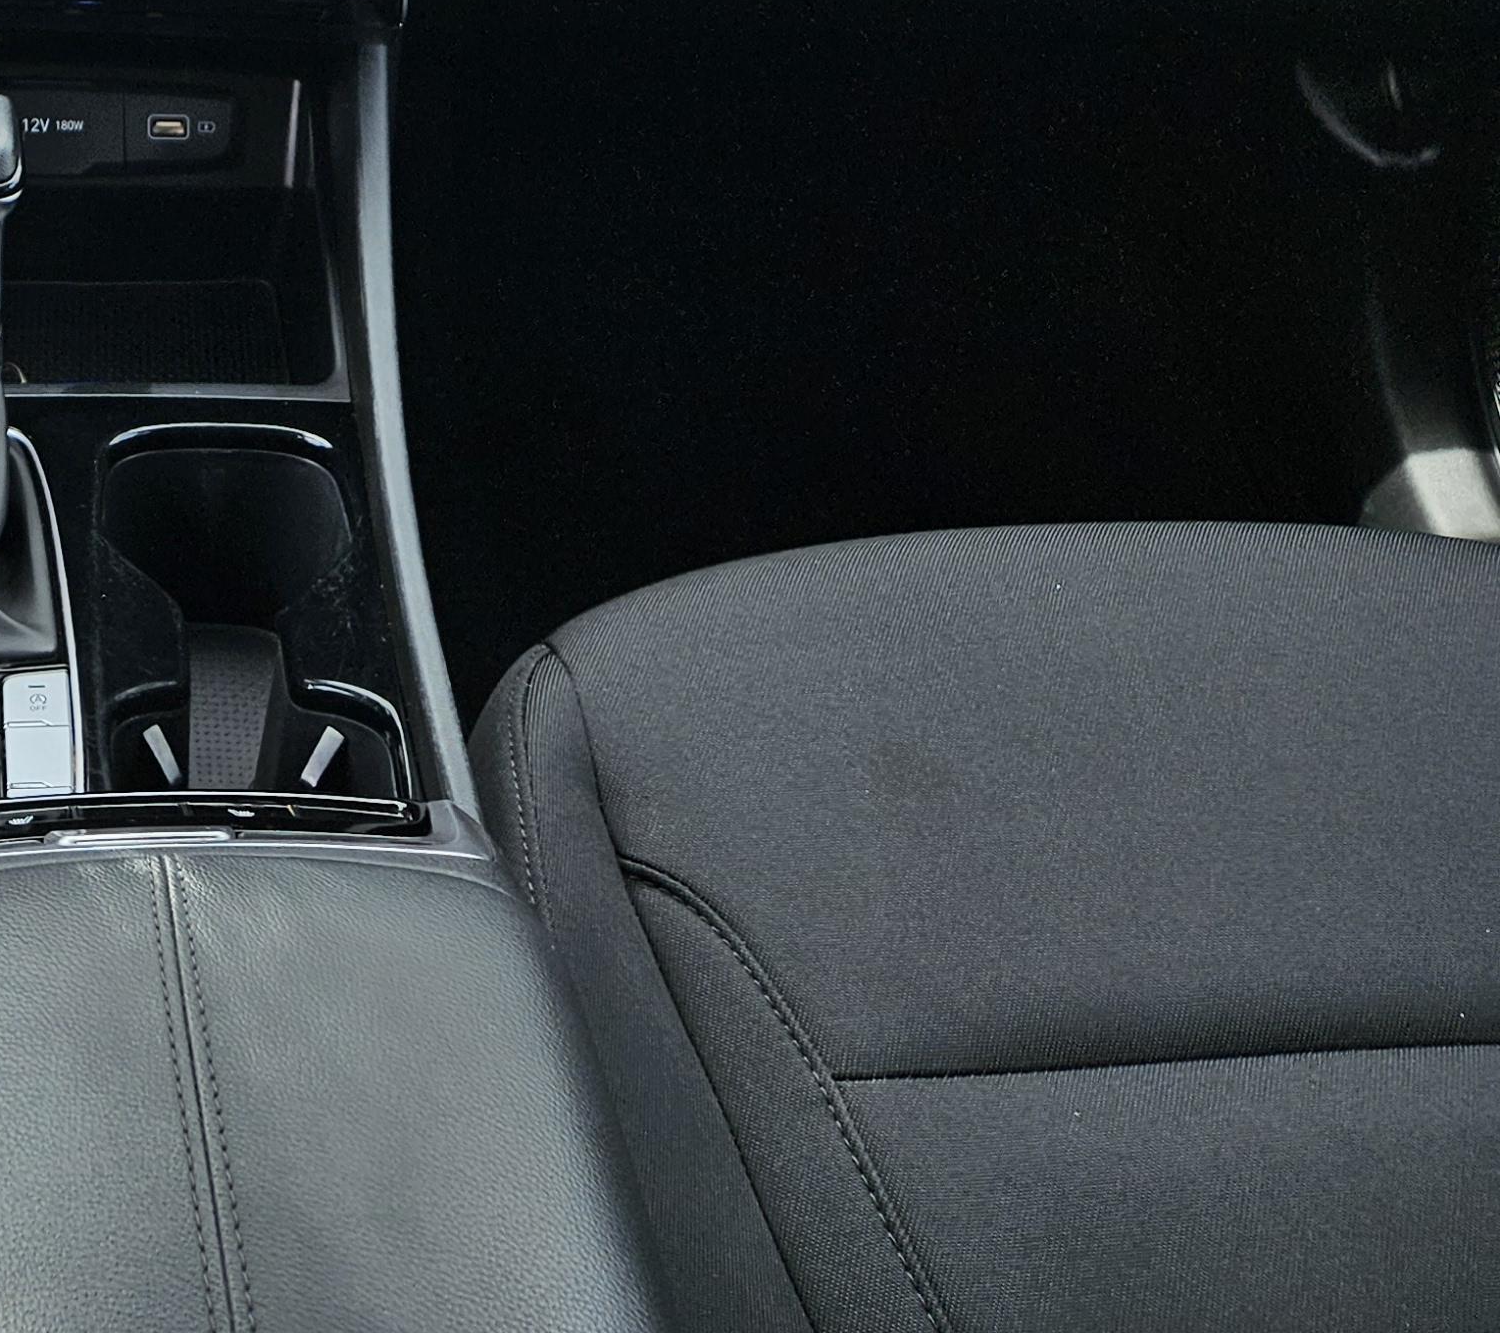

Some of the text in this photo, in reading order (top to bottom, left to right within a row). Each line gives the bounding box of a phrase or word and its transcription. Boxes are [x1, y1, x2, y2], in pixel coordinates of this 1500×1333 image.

[22, 118, 84, 133] 12V 180W
[30, 704, 48, 712] OFF
